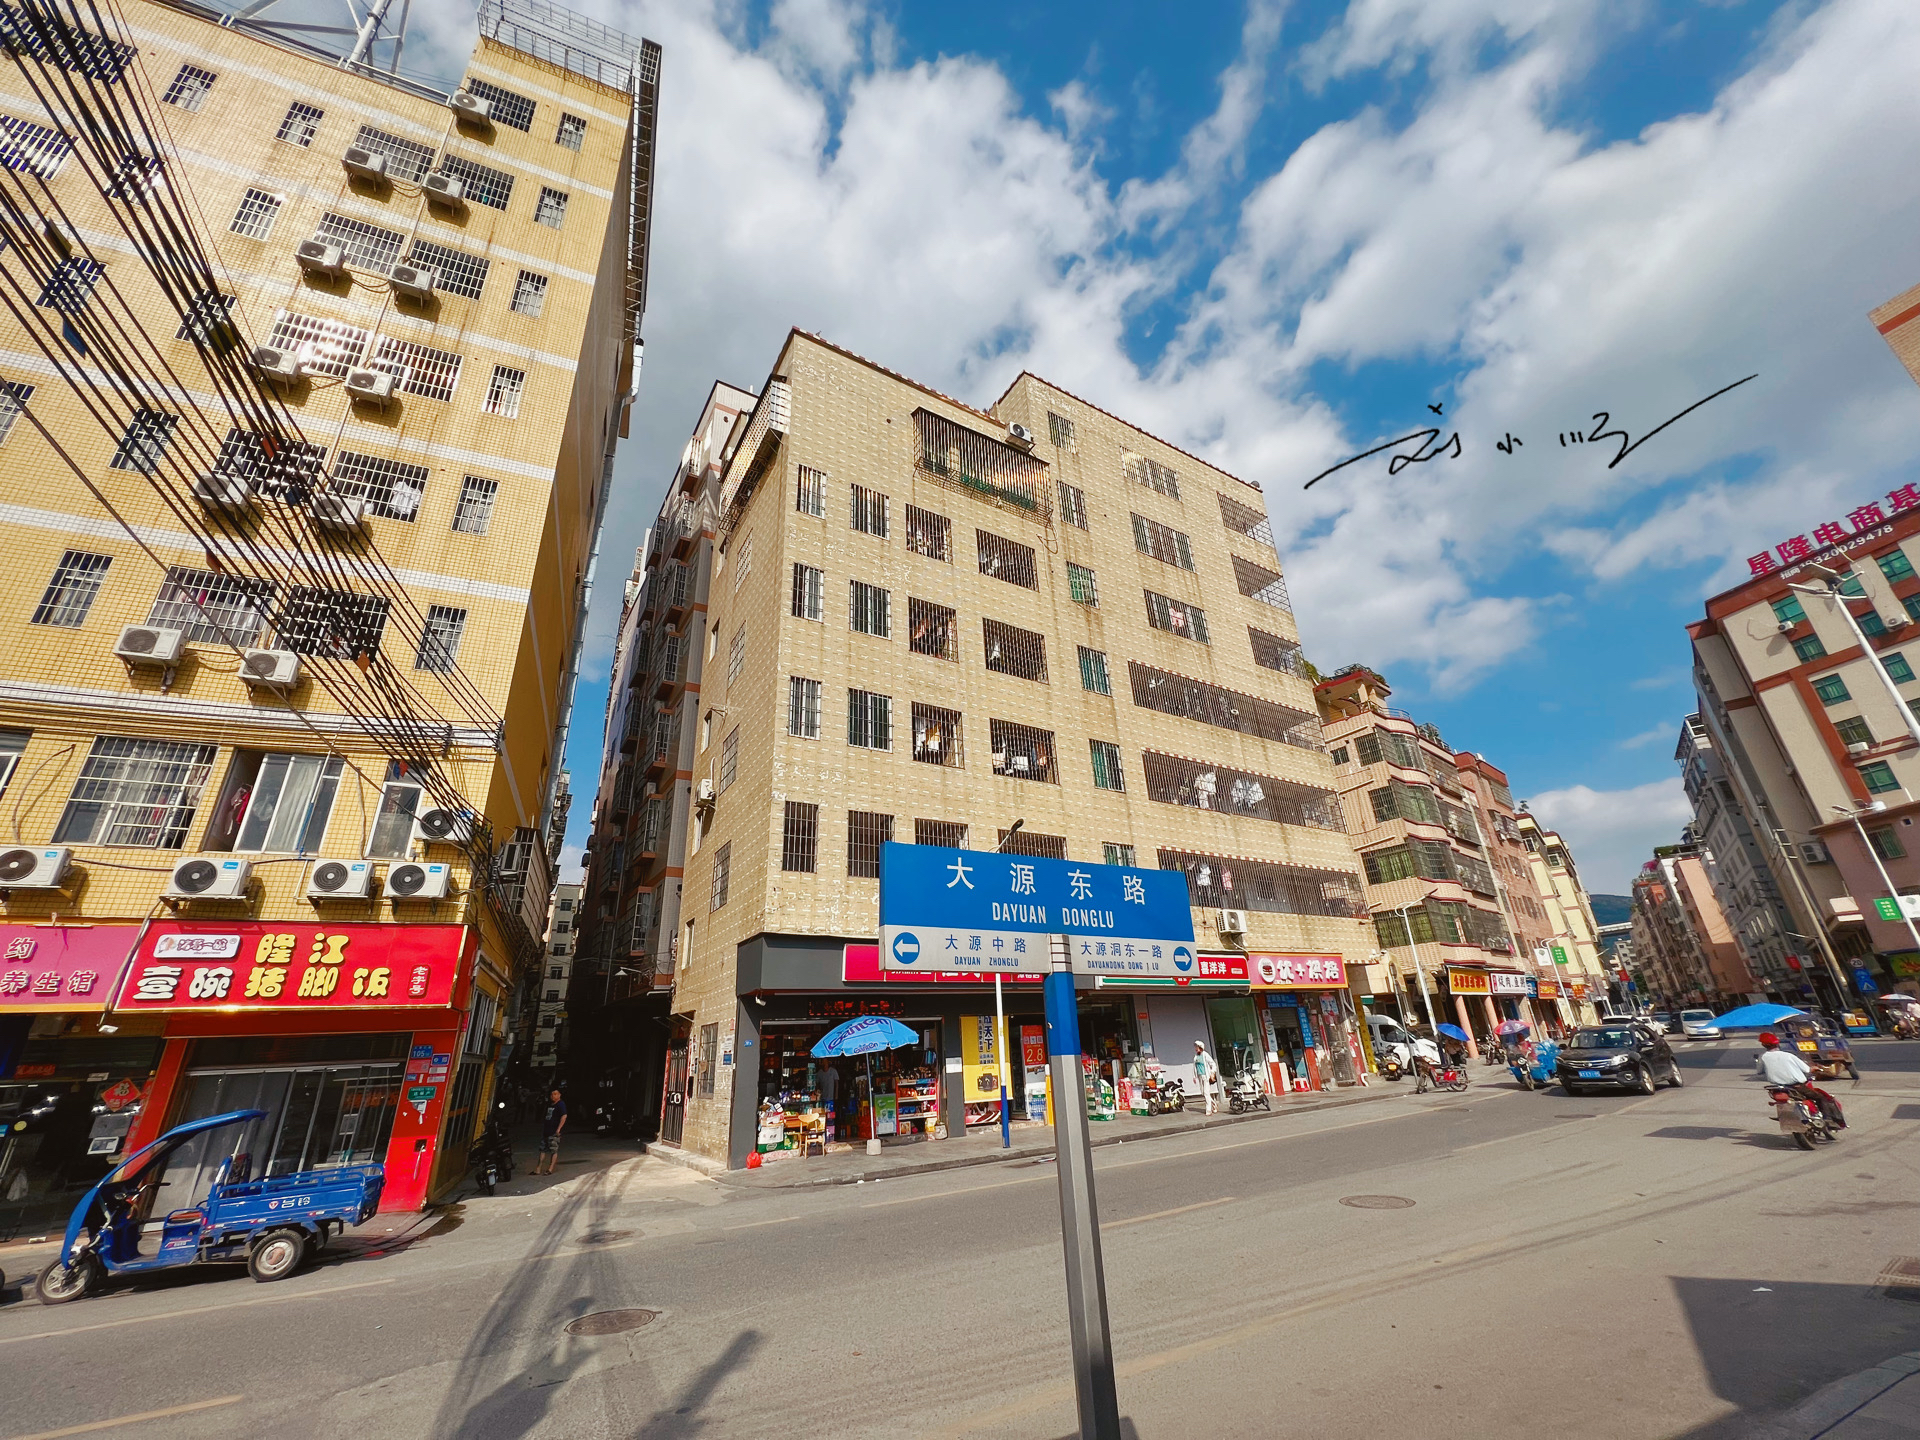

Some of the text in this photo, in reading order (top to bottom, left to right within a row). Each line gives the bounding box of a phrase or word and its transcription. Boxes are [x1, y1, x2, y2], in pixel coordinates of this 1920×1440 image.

[946, 856, 1146, 906] 大源东路
[992, 902, 1114, 929] DAYUAN DONGLU
[3, 937, 37, 960] 约
[255, 932, 350, 964] 隆江
[945, 934, 1027, 954] 大源中路
[1080, 941, 1163, 959] 大源洞东一路
[954, 955, 1019, 968] DAYUAN ZHONGLU
[1200, 961, 1227, 975] 喜洋洋
[0, 969, 96, 994] 养生馆
[408, 965, 429, 996] 老字号
[1026, 1048, 1043, 1062] 2.8
